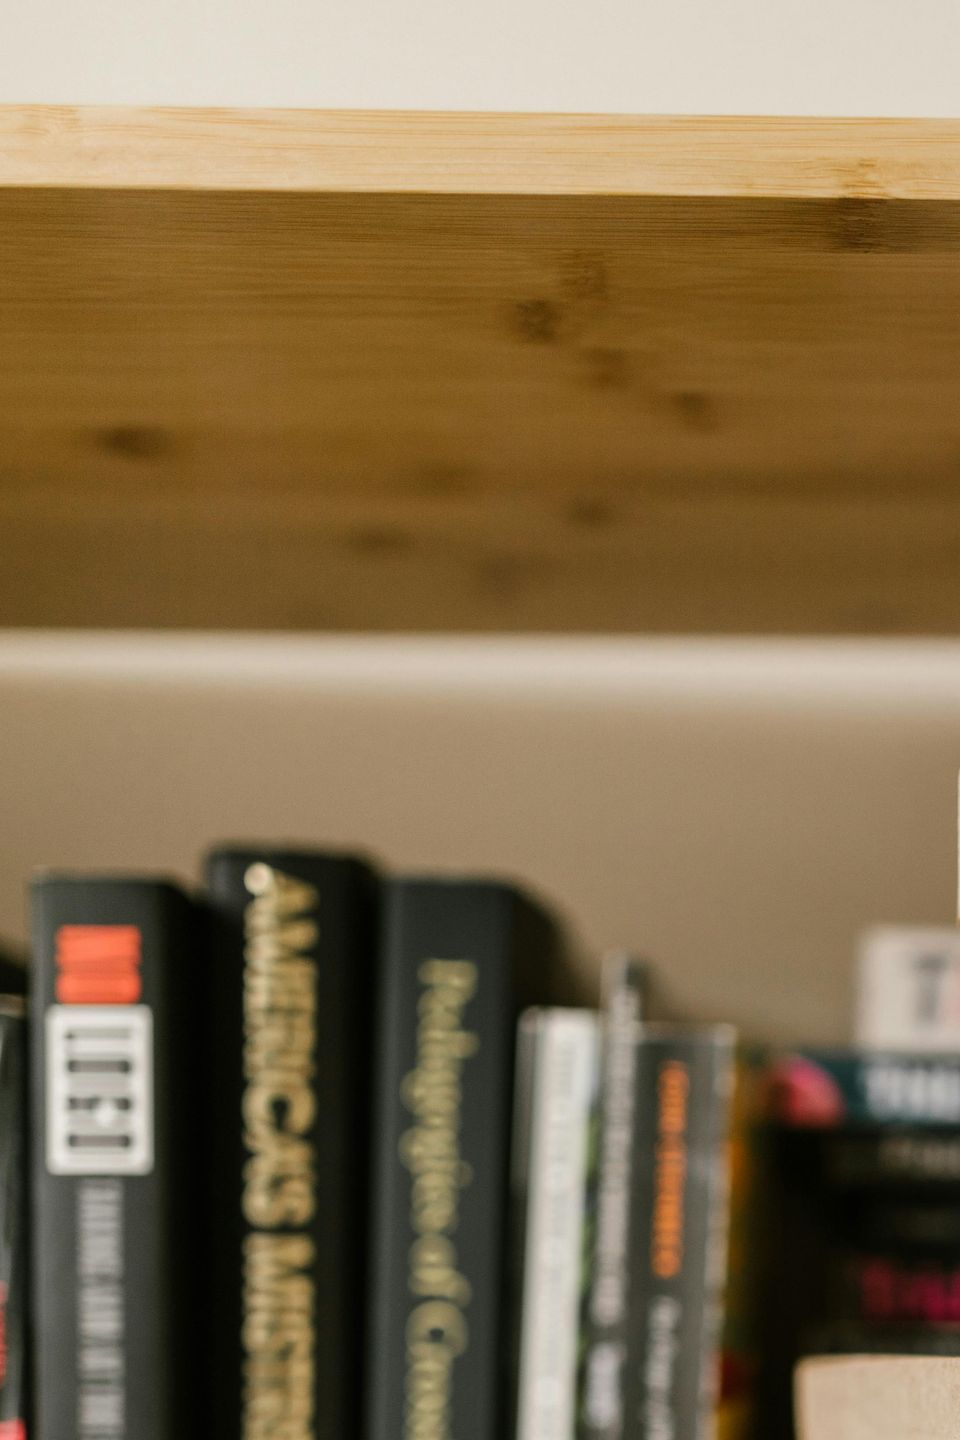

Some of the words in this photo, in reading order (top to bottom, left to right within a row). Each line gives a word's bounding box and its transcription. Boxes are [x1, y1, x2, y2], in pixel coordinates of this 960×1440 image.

[50, 1012, 148, 1168] LOGO
[242, 864, 318, 1227] AMERICA'S
[402, 959, 477, 1234] Pedagogies
